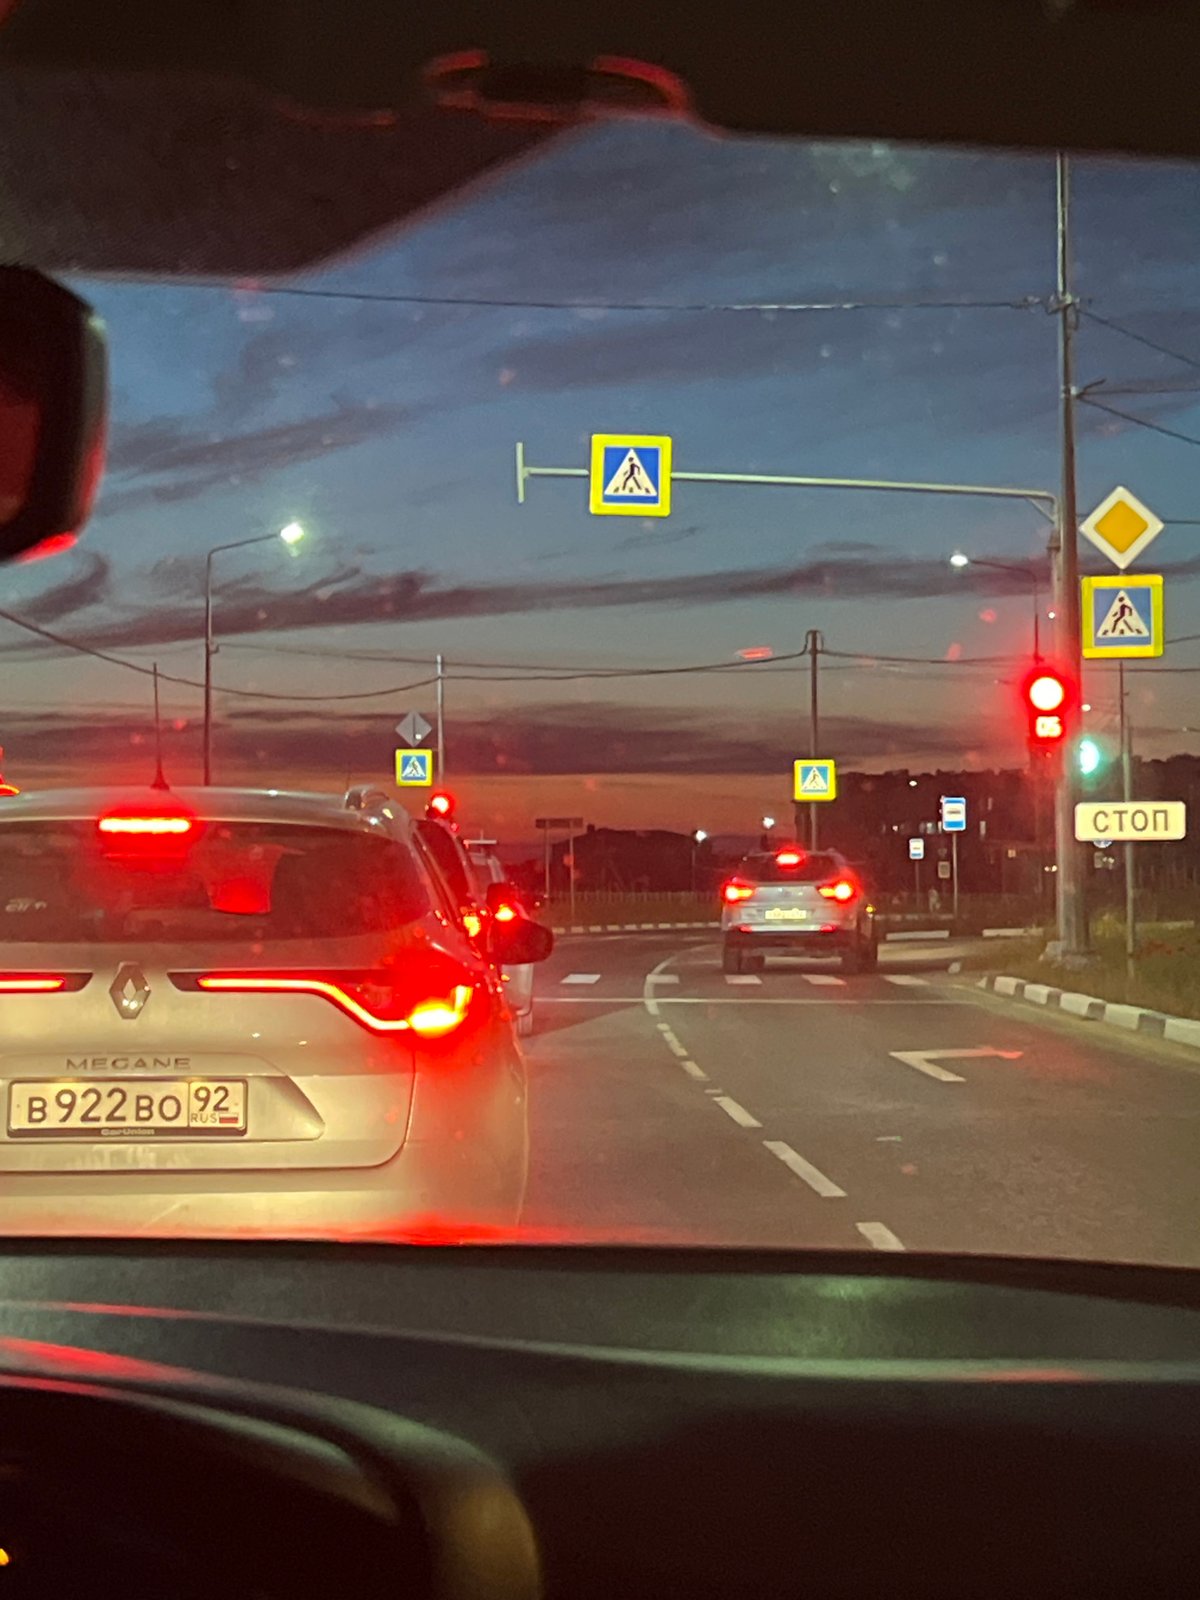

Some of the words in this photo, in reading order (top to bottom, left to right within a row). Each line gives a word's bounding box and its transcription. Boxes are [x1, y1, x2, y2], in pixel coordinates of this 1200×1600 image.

[1092, 809, 1169, 833] СТОП
[66, 1057, 191, 1070] MEGANE
[27, 1088, 181, 1123] В922ВО
[193, 1086, 230, 1112] 92
[191, 1113, 218, 1124] RUS
